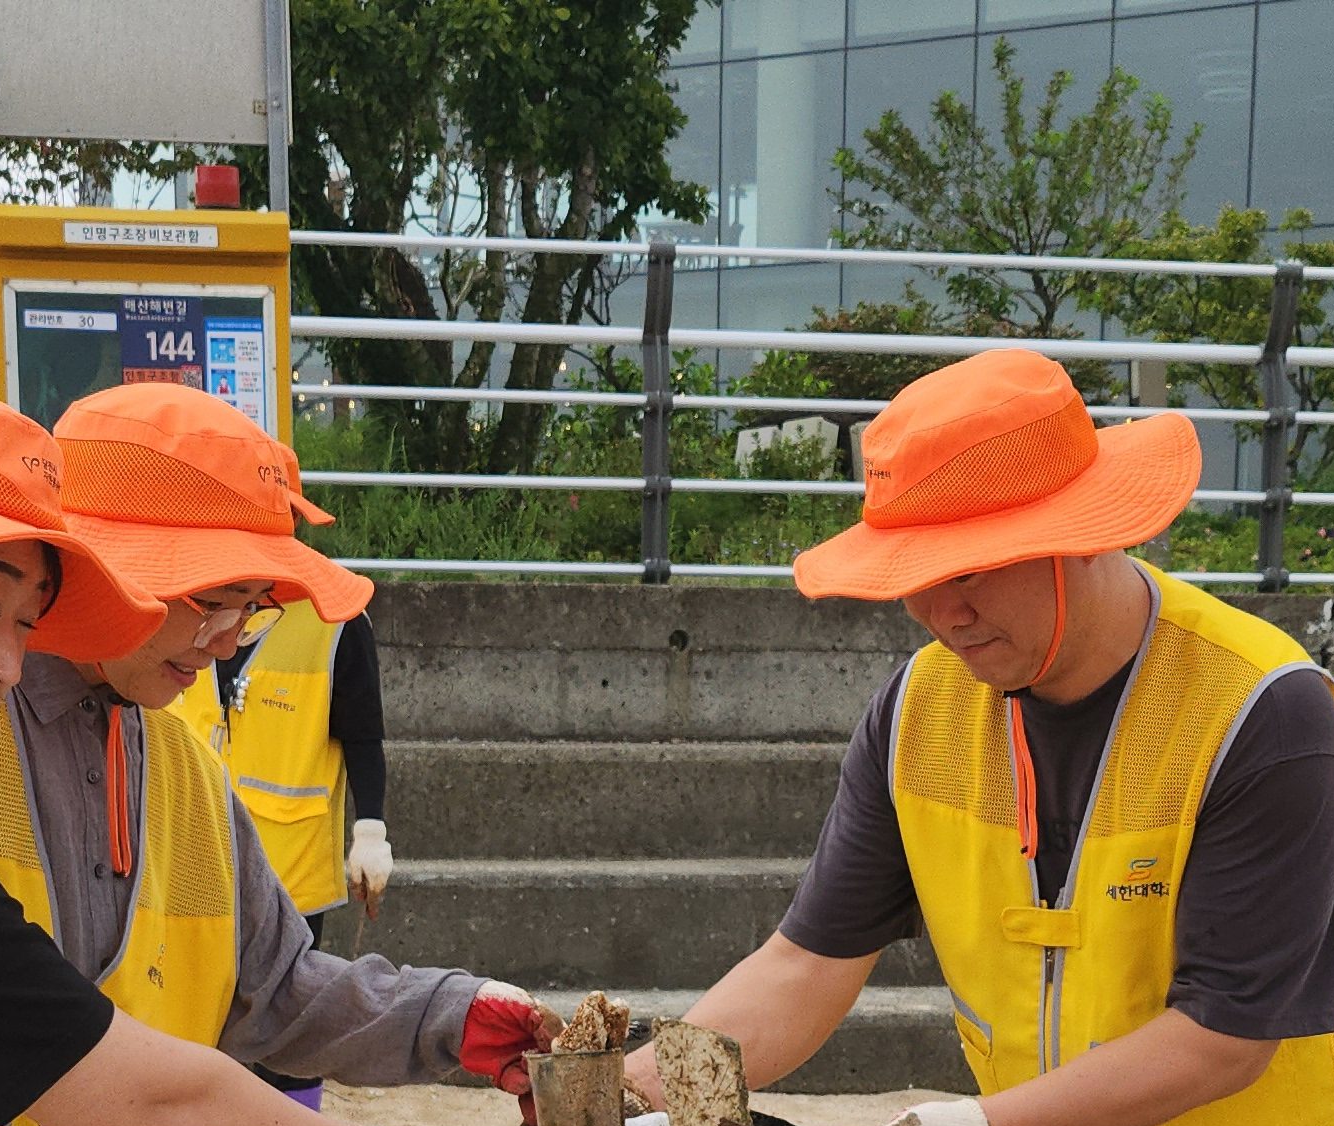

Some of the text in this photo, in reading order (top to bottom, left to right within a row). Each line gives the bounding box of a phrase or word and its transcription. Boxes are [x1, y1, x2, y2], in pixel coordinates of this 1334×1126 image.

[82, 226, 199, 244] 인명구조장비보관함
[78, 315, 95, 328] 30
[146, 331, 196, 362] 144
